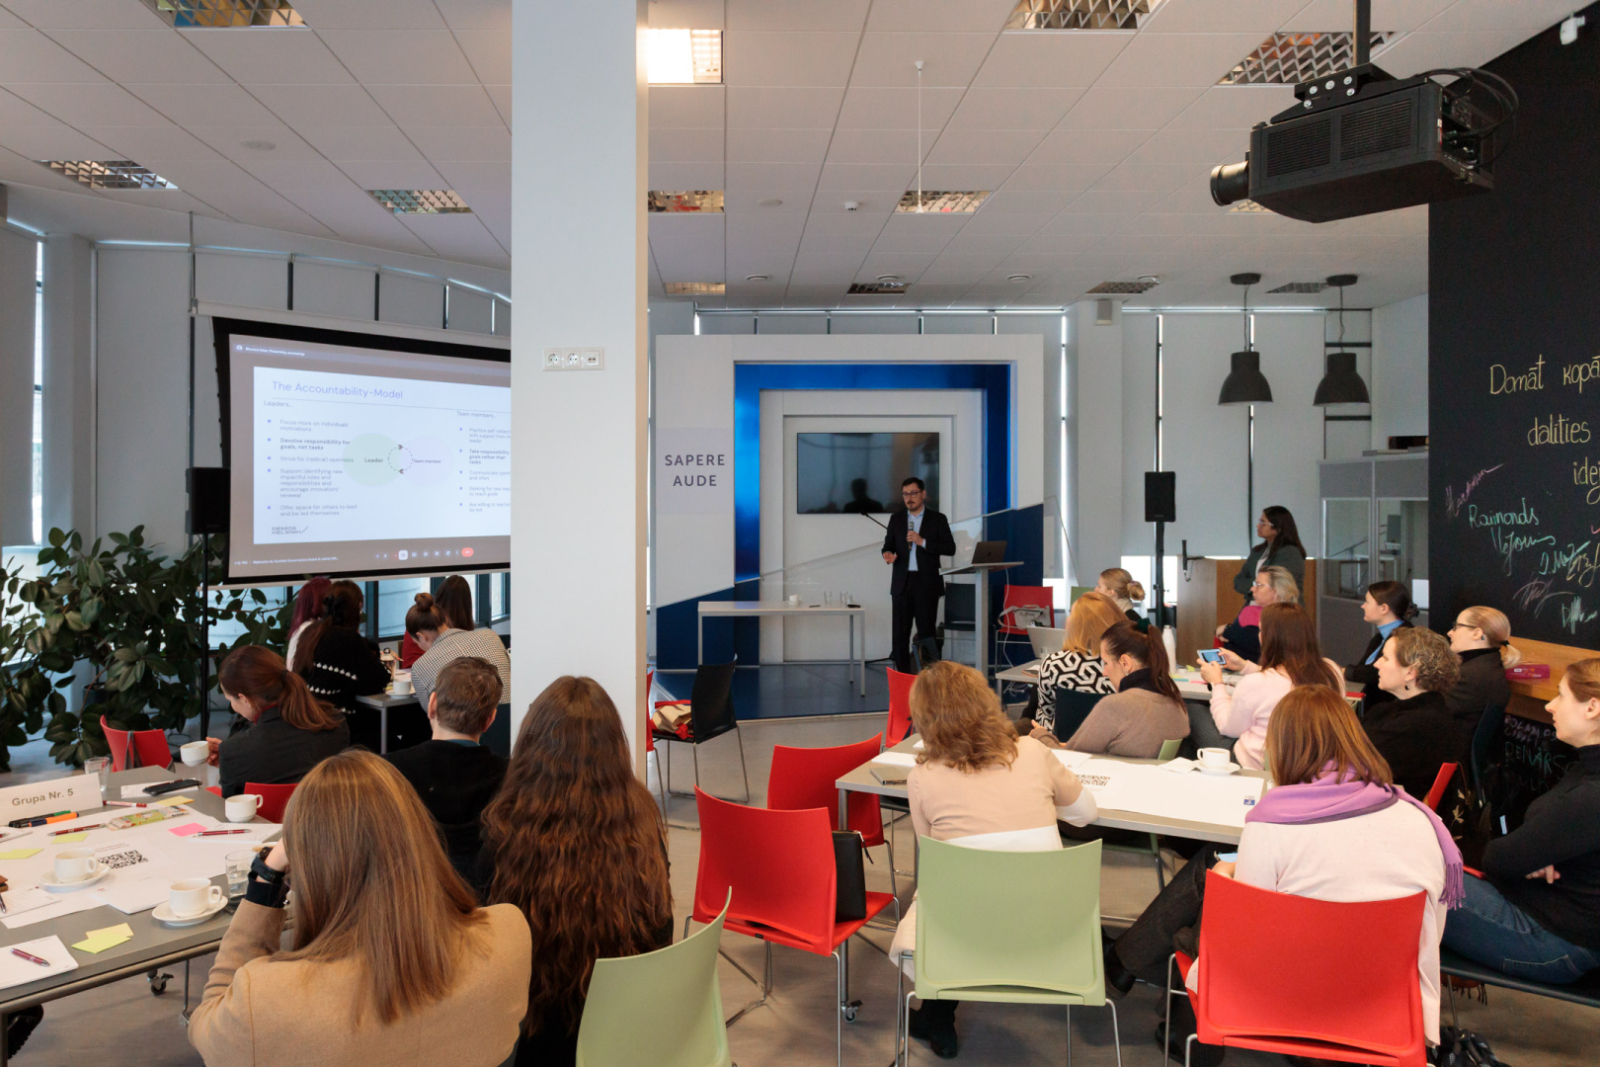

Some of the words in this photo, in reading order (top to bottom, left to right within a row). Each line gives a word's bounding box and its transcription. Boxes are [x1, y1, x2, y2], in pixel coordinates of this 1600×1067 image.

[1490, 353, 1546, 395] Domāt
[272, 381, 292, 392] The
[295, 383, 403, 399] Accountability-Model
[304, 438, 342, 446] responsibility
[665, 454, 725, 466] SAPERE
[673, 475, 717, 487] AUDE
[1469, 497, 1539, 529] Raimonds
[12, 794, 46, 806] Grupa
[48, 791, 64, 800] Nr.
[68, 788, 74, 796] 5
